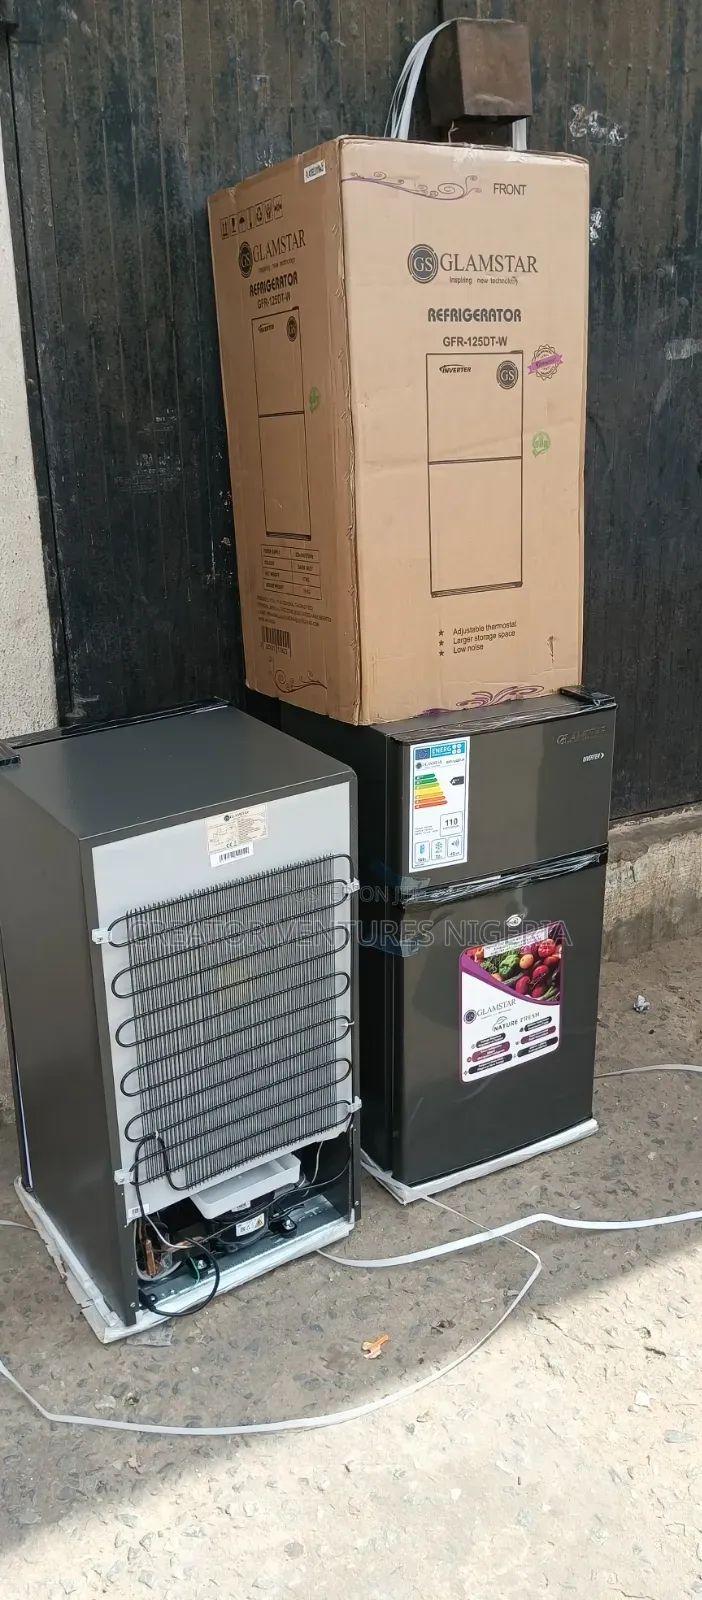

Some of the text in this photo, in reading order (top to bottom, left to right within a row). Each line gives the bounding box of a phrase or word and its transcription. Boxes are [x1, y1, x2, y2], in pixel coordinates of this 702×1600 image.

[493, 183, 527, 195] FRONT
[253, 229, 306, 263] GLAMSTAR
[413, 256, 433, 272] GS
[440, 253, 538, 273] GLAMSTAR
[249, 271, 299, 297] REFRIGERATOR
[257, 291, 291, 309] GFR-125DT-W
[428, 308, 522, 322] REFRIGERATOR
[443, 336, 508, 347] GFR-125DT-W
[442, 366, 472, 374] INVERTER
[500, 369, 515, 381] GS
[453, 621, 517, 636] Adjustable thermostat
[453, 631, 516, 645] Larger storage space
[453, 644, 484, 654] Low noise
[444, 817, 459, 827] 110
[476, 998, 516, 1017] GLAMSTAR
[493, 1019, 518, 1032] NATURE
[520, 1011, 540, 1023] FRESH
